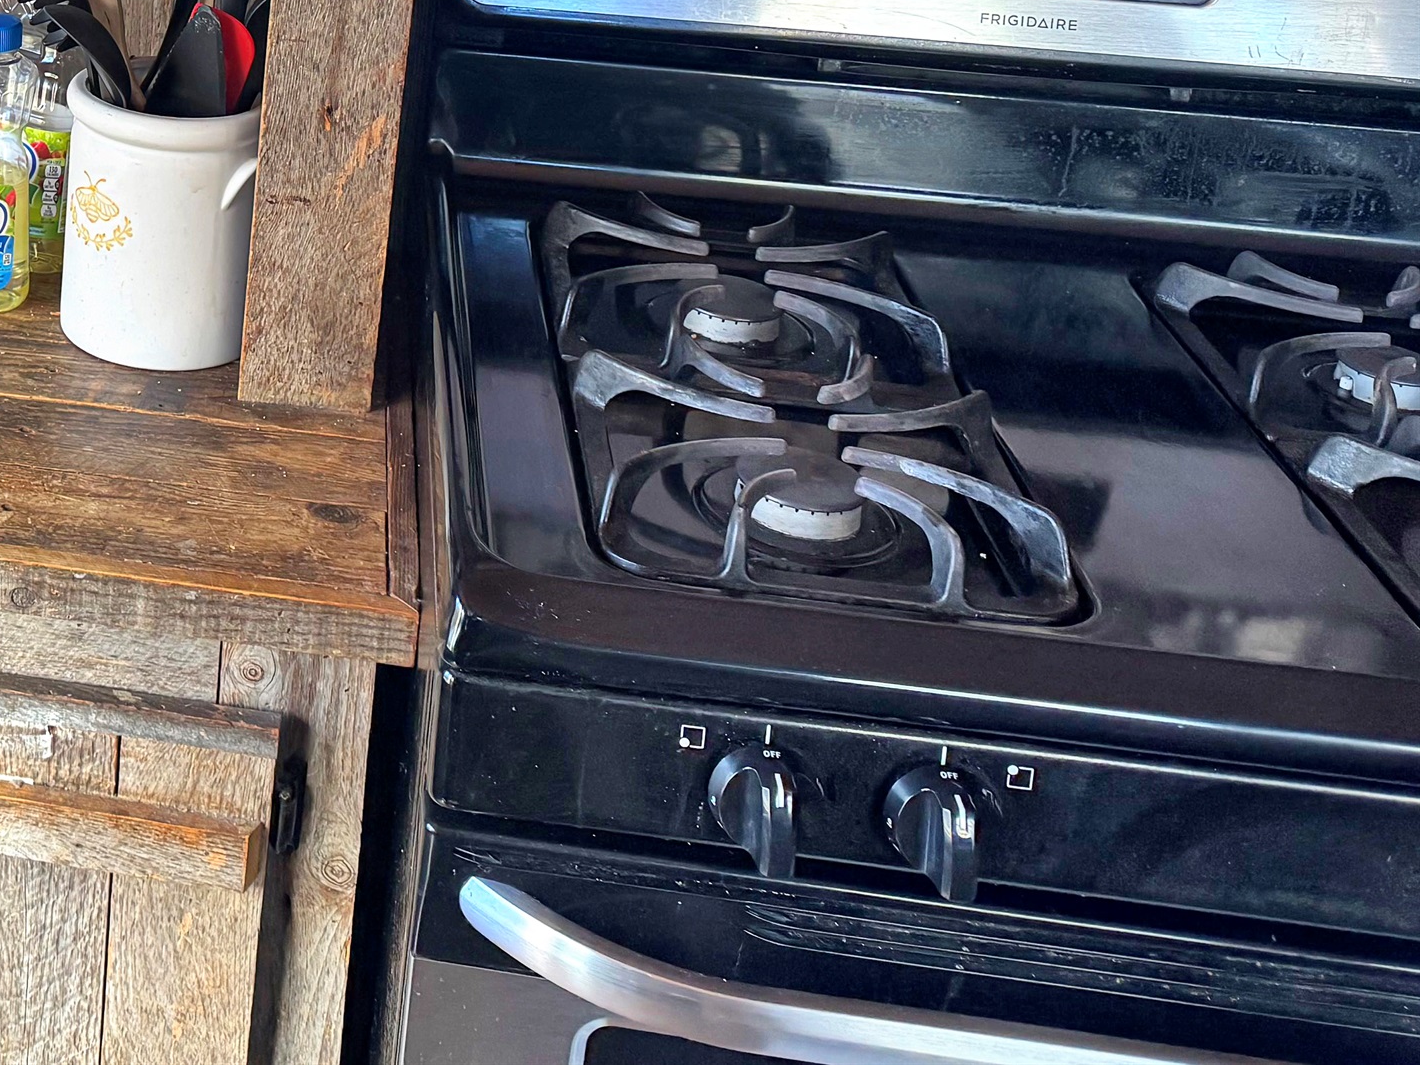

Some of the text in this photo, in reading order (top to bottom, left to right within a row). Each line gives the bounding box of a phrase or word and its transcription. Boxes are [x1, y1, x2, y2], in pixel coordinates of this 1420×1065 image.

[980, 13, 1078, 31] FRIGIDAIRE
[762, 749, 782, 759] OFF
[939, 770, 959, 780] OFF
